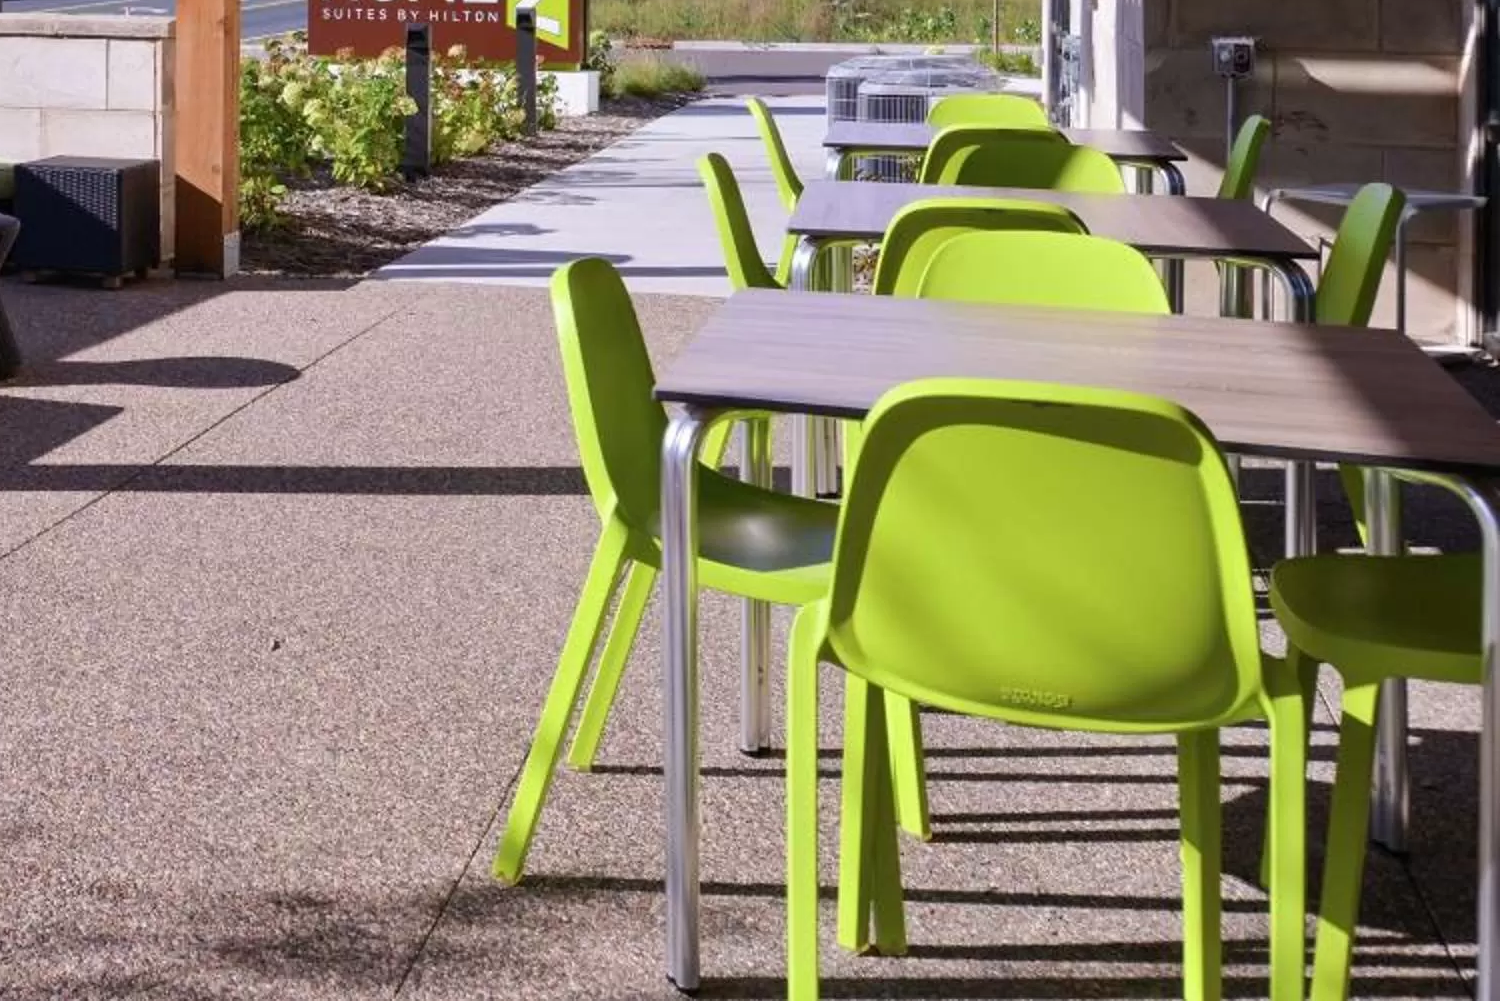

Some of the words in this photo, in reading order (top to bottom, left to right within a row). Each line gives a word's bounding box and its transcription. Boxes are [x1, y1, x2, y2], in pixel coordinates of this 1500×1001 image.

[322, 8, 388, 20] SUITES
[397, 9, 420, 21] BY
[428, 10, 499, 23] HILTON
